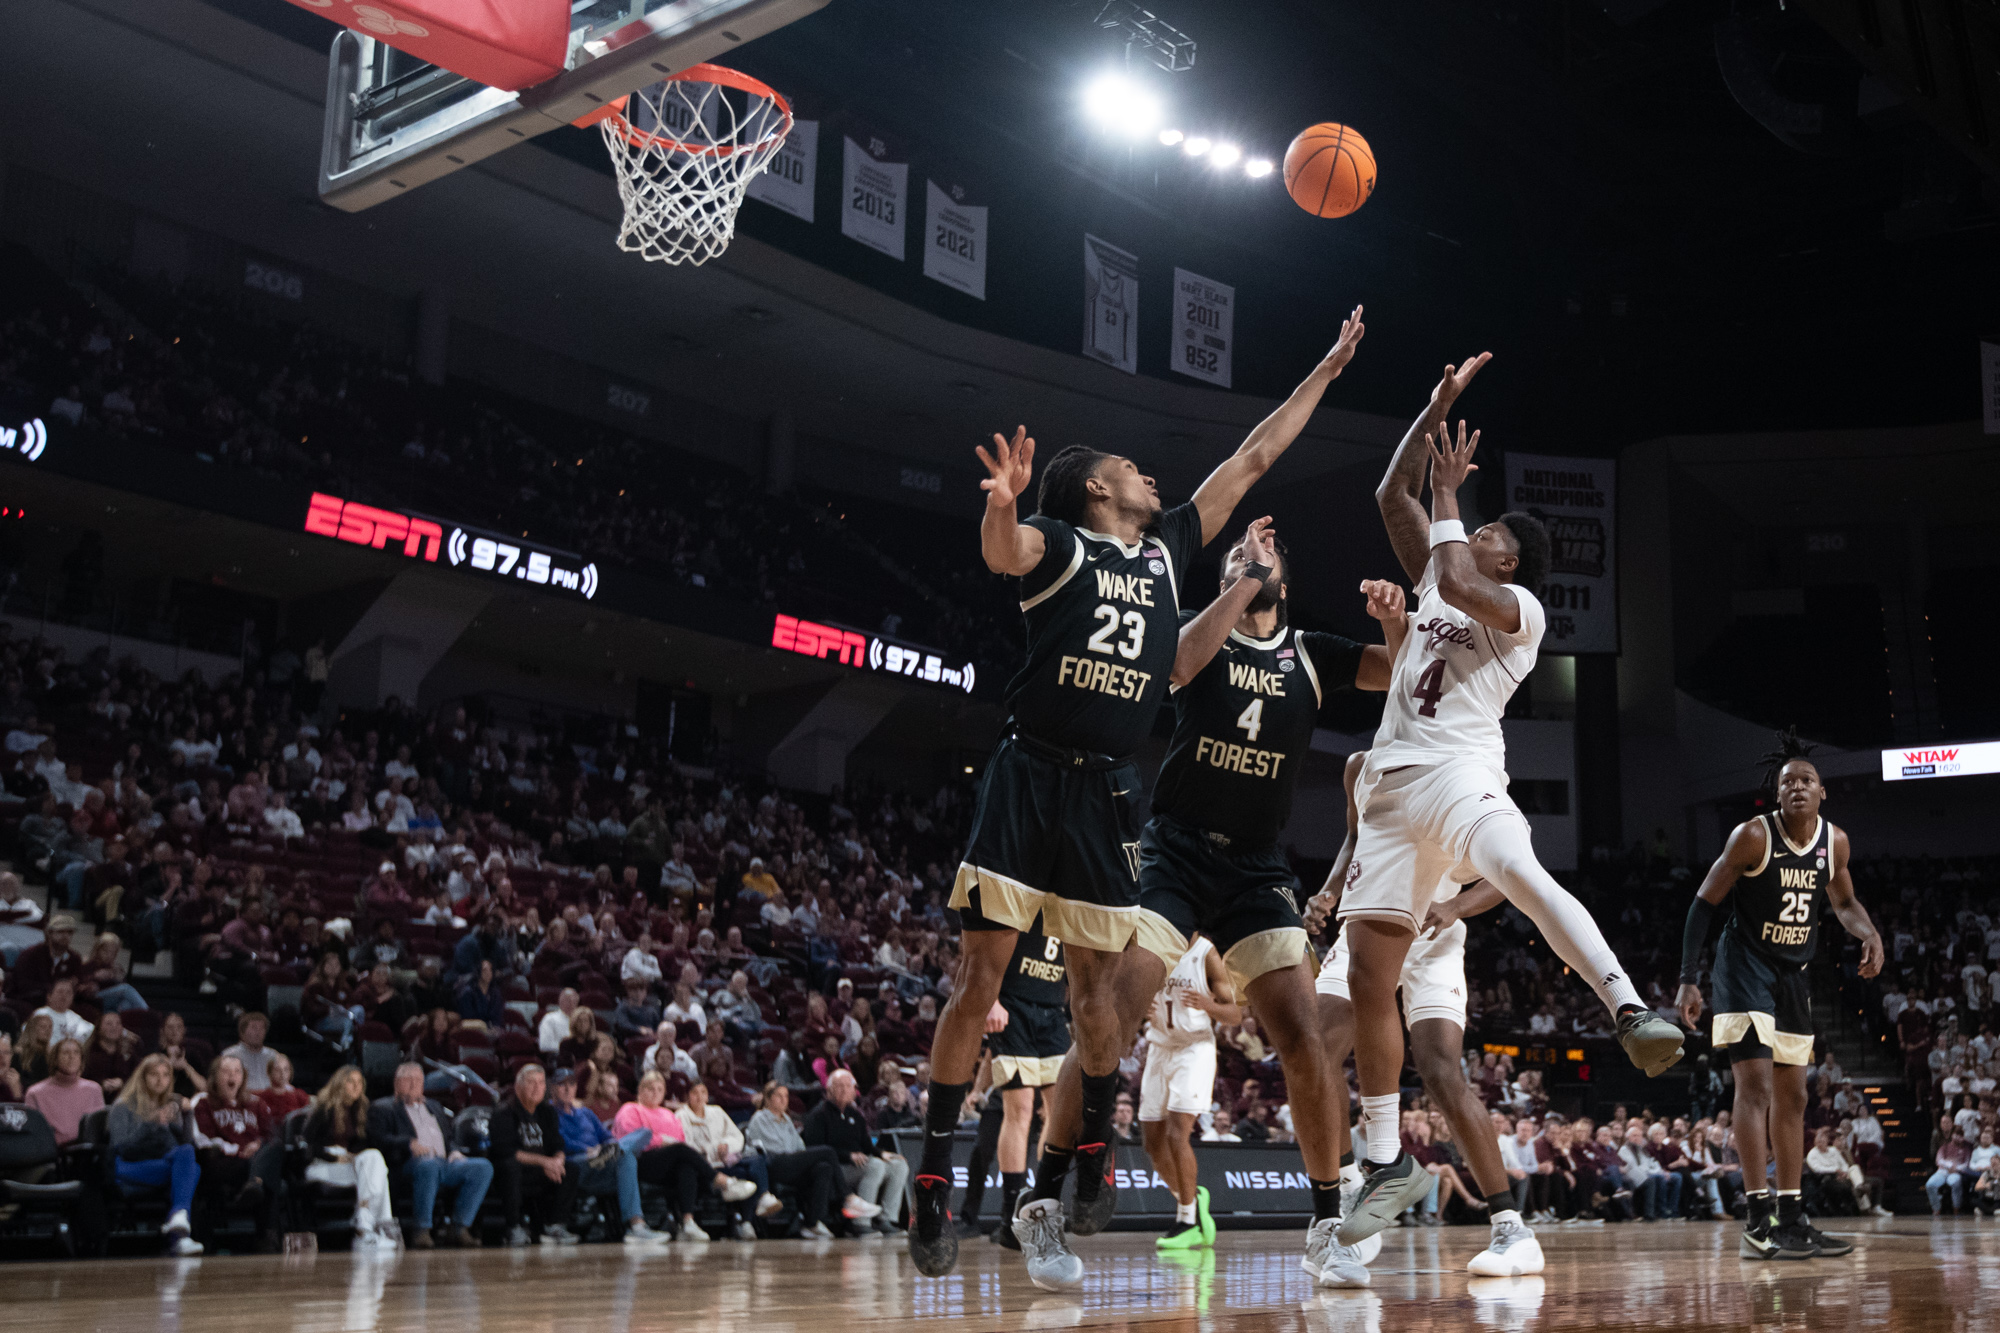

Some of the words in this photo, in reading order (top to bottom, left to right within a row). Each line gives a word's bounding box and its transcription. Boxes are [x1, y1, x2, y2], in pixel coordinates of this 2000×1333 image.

[771, 152, 803, 185] 010
[852, 186, 896, 226] 2013
[936, 224, 976, 262] 2021
[1187, 302, 1220, 330] 2011
[1186, 345, 1218, 373] 852
[608, 385, 649, 414] 207
[1524, 469, 1595, 489] NATIONAL
[1514, 487, 1605, 508] CHAMPIONS
[304, 491, 442, 562] ESPN
[471, 537, 551, 584] 97.5
[551, 567, 579, 590] FM
[1095, 569, 1155, 607] WAKE
[1087, 604, 1146, 660] 23
[772, 613, 866, 668] ESPN
[885, 645, 942, 682] 97.5
[941, 668, 961, 686] FM
[1058, 655, 1151, 702] FOREST
[1229, 662, 1286, 697] WAKE
[1412, 659, 1447, 718] 4
[1237, 698, 1263, 741] 4
[1195, 736, 1285, 779] FOREST
[1903, 749, 1959, 764] WTAW
[1780, 868, 1818, 889] WAKE
[1779, 891, 1812, 923] 25
[1761, 921, 1811, 944] FOREST
[1044, 935, 1061, 961] 6
[1019, 956, 1065, 982] FOREST
[1165, 1000, 1174, 1029] 1
[1115, 1168, 1169, 1189] SSA
[1225, 1171, 1312, 1189] NISSAN
